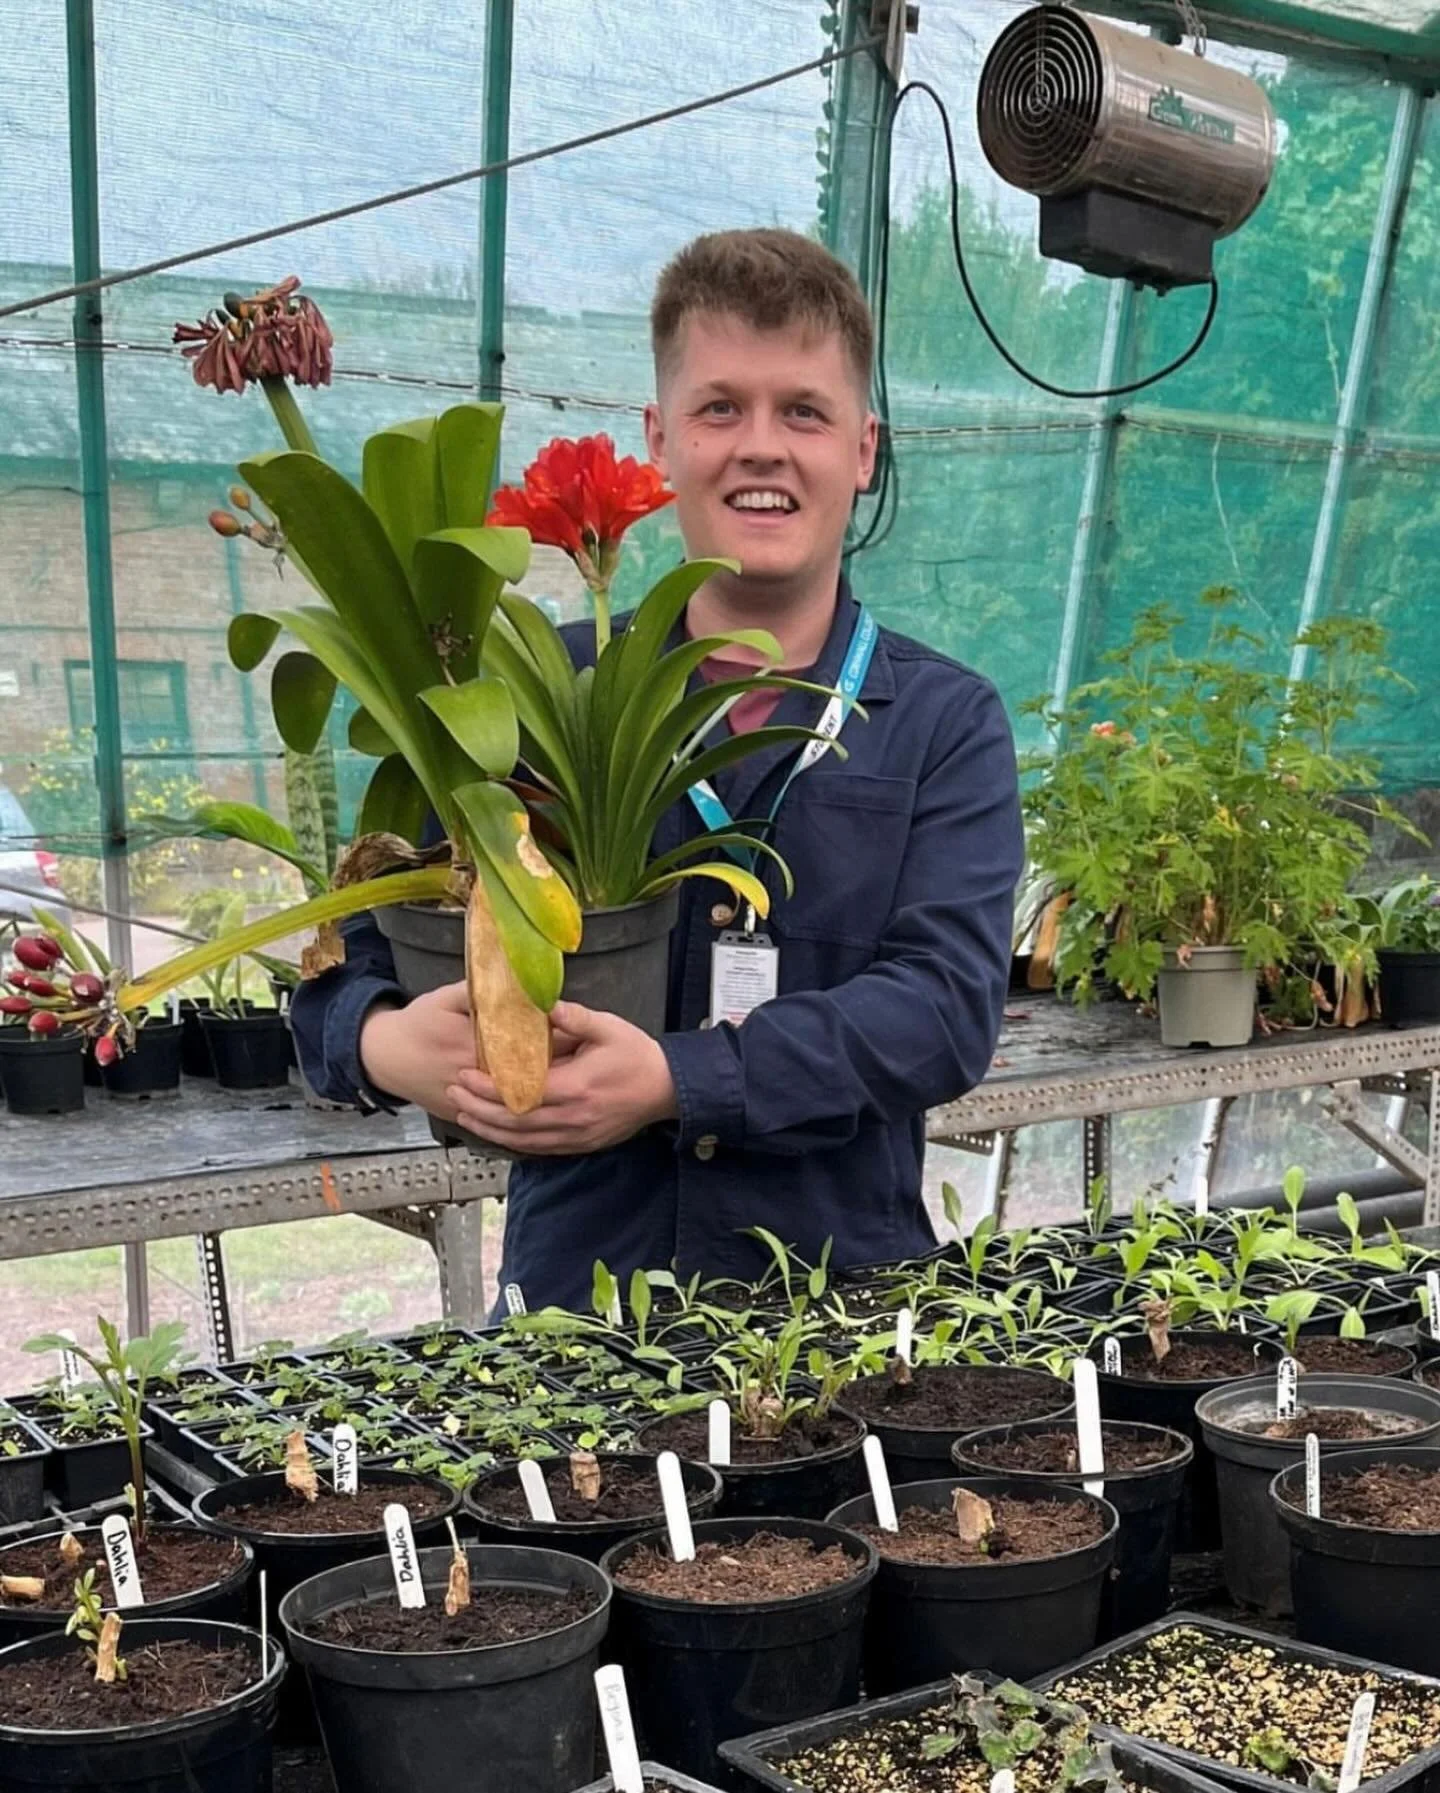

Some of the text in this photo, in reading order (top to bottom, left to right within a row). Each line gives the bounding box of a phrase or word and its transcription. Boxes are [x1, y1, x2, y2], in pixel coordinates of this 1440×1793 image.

[335, 1439, 352, 1490] Dahlia
[106, 1530, 129, 1587] Dahlia
[392, 1526, 414, 1583] Dahlia
